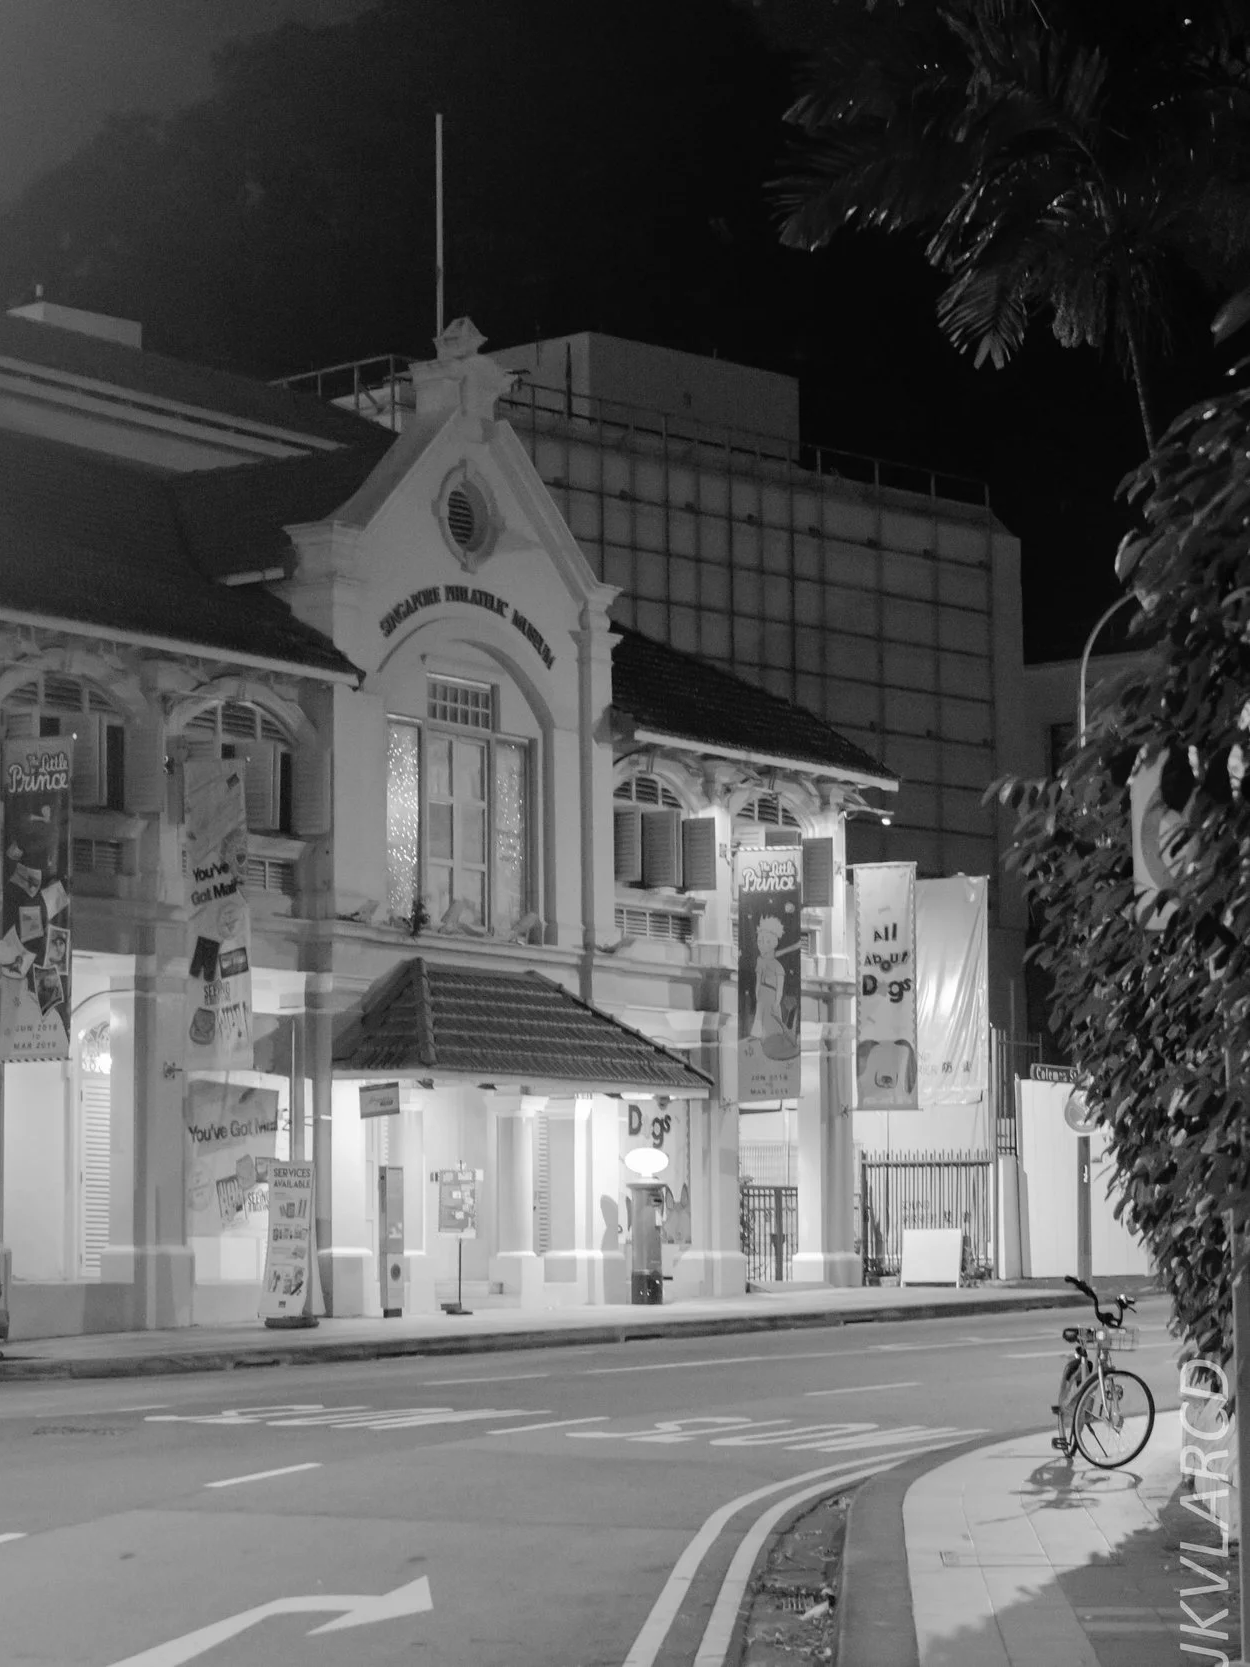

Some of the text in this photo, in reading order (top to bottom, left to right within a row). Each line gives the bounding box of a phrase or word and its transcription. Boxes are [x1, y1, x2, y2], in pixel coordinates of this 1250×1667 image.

[379, 584, 556, 670] SINGAPORE PHILATELIC MUSEUM
[39, 752, 69, 772] Little
[9, 764, 69, 793] Prince
[192, 861, 230, 883] You've
[769, 860, 796, 877] Little
[742, 868, 795, 892] Prince
[191, 887, 212, 906] Got
[873, 922, 897, 942] All
[1036, 1066, 1067, 1081] Coleman
[188, 1123, 227, 1143] You've
[230, 1120, 253, 1137] Got
[273, 1168, 311, 1178] SERVICES
[273, 1179, 311, 1189] AVAILABLE
